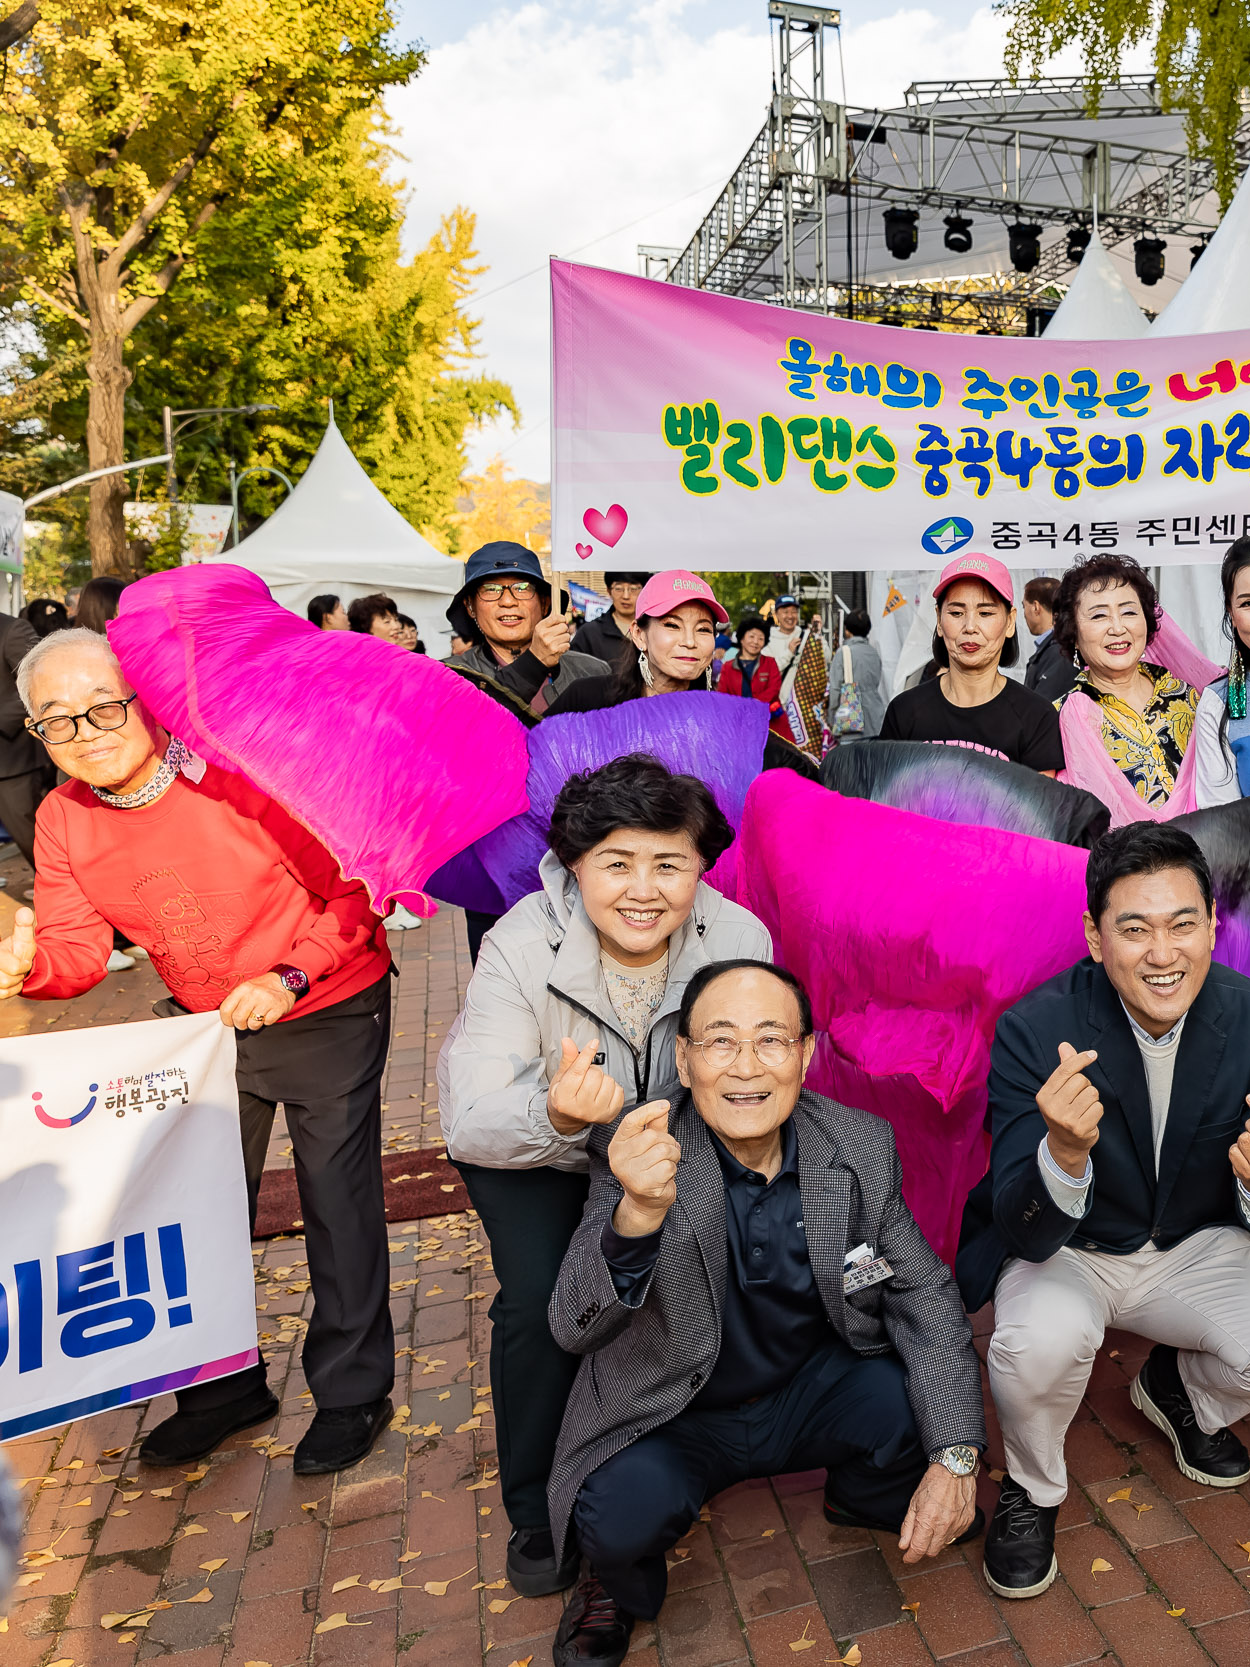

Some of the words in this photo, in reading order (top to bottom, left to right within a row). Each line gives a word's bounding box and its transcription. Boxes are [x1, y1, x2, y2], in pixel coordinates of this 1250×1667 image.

[777, 337, 943, 410] 올해의
[960, 367, 1152, 421] 주인공은
[661, 399, 899, 497] 밸리댄스
[913, 421, 1146, 501] 중곡4동의
[991, 521, 1119, 549] 중곡4동
[106, 1076, 143, 1093] 소통하며
[144, 1067, 187, 1088] 발전하는
[104, 1081, 189, 1118] 행복광진
